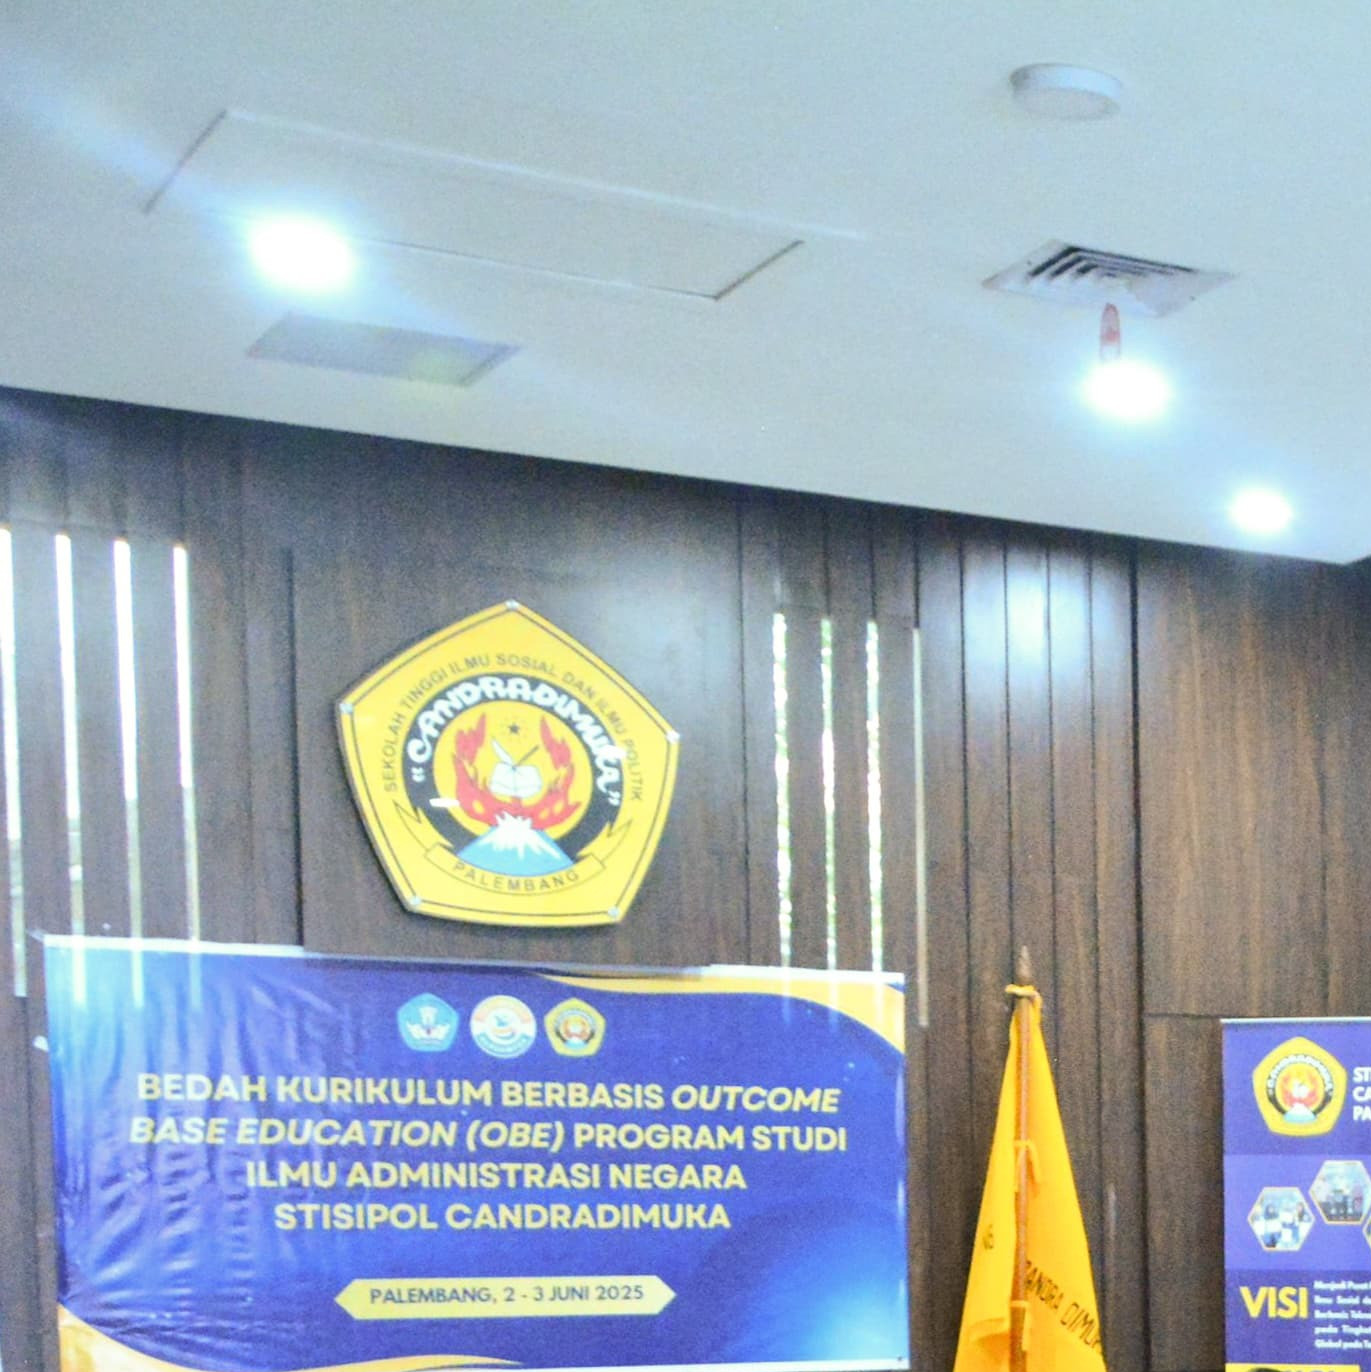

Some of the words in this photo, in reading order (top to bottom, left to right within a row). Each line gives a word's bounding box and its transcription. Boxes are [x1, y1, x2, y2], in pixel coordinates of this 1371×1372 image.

[383, 712, 407, 792] SEKOLAH
[403, 667, 449, 712] TINGGI
[449, 653, 491, 676] ILMU
[495, 653, 558, 677] SOSIAL
[561, 671, 597, 700] DAN
[452, 861, 580, 892] PALEMBANG
[137, 1073, 268, 1102] BEDAH
[276, 1075, 493, 1106] KURIKULUM
[501, 1081, 664, 1110] BERBASIS
[671, 1084, 842, 1113] OUTCOME
[129, 1117, 228, 1144] BASE
[236, 1118, 458, 1148] EDUCATION
[466, 1119, 565, 1152] (OBE)
[574, 1123, 744, 1150] PROGRAM
[752, 1126, 847, 1152] STUDI
[246, 1160, 337, 1188] ILMU
[346, 1161, 600, 1189] ADMINISTRASI
[609, 1163, 748, 1190] NEGARA
[274, 1203, 439, 1230] STISIPOL
[445, 1203, 732, 1230] CANDRADIMUKA
[369, 1286, 498, 1305] PALEMBANG,
[503, 1286, 516, 1302] 2
[532, 1286, 544, 1302] 3
[548, 1285, 590, 1302] JUNI
[598, 1284, 645, 1301] 2025
[1239, 1286, 1309, 1319] VISI
